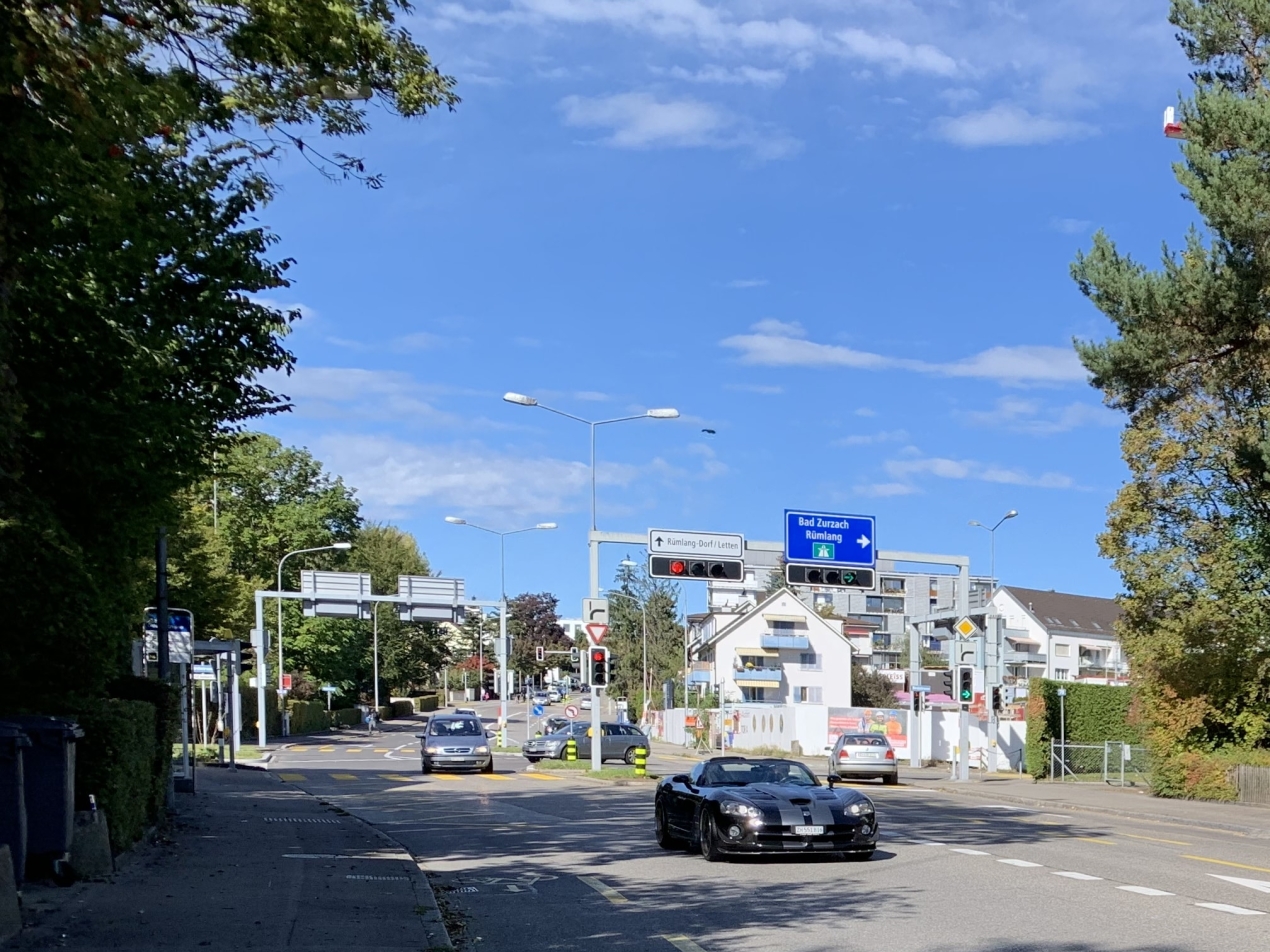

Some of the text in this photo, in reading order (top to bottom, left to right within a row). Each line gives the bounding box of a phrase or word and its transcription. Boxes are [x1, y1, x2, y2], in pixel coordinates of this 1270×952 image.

[798, 516, 850, 529] Bad Zurzach
[805, 530, 843, 544] Rümlang
[717, 541, 739, 550] Letten
